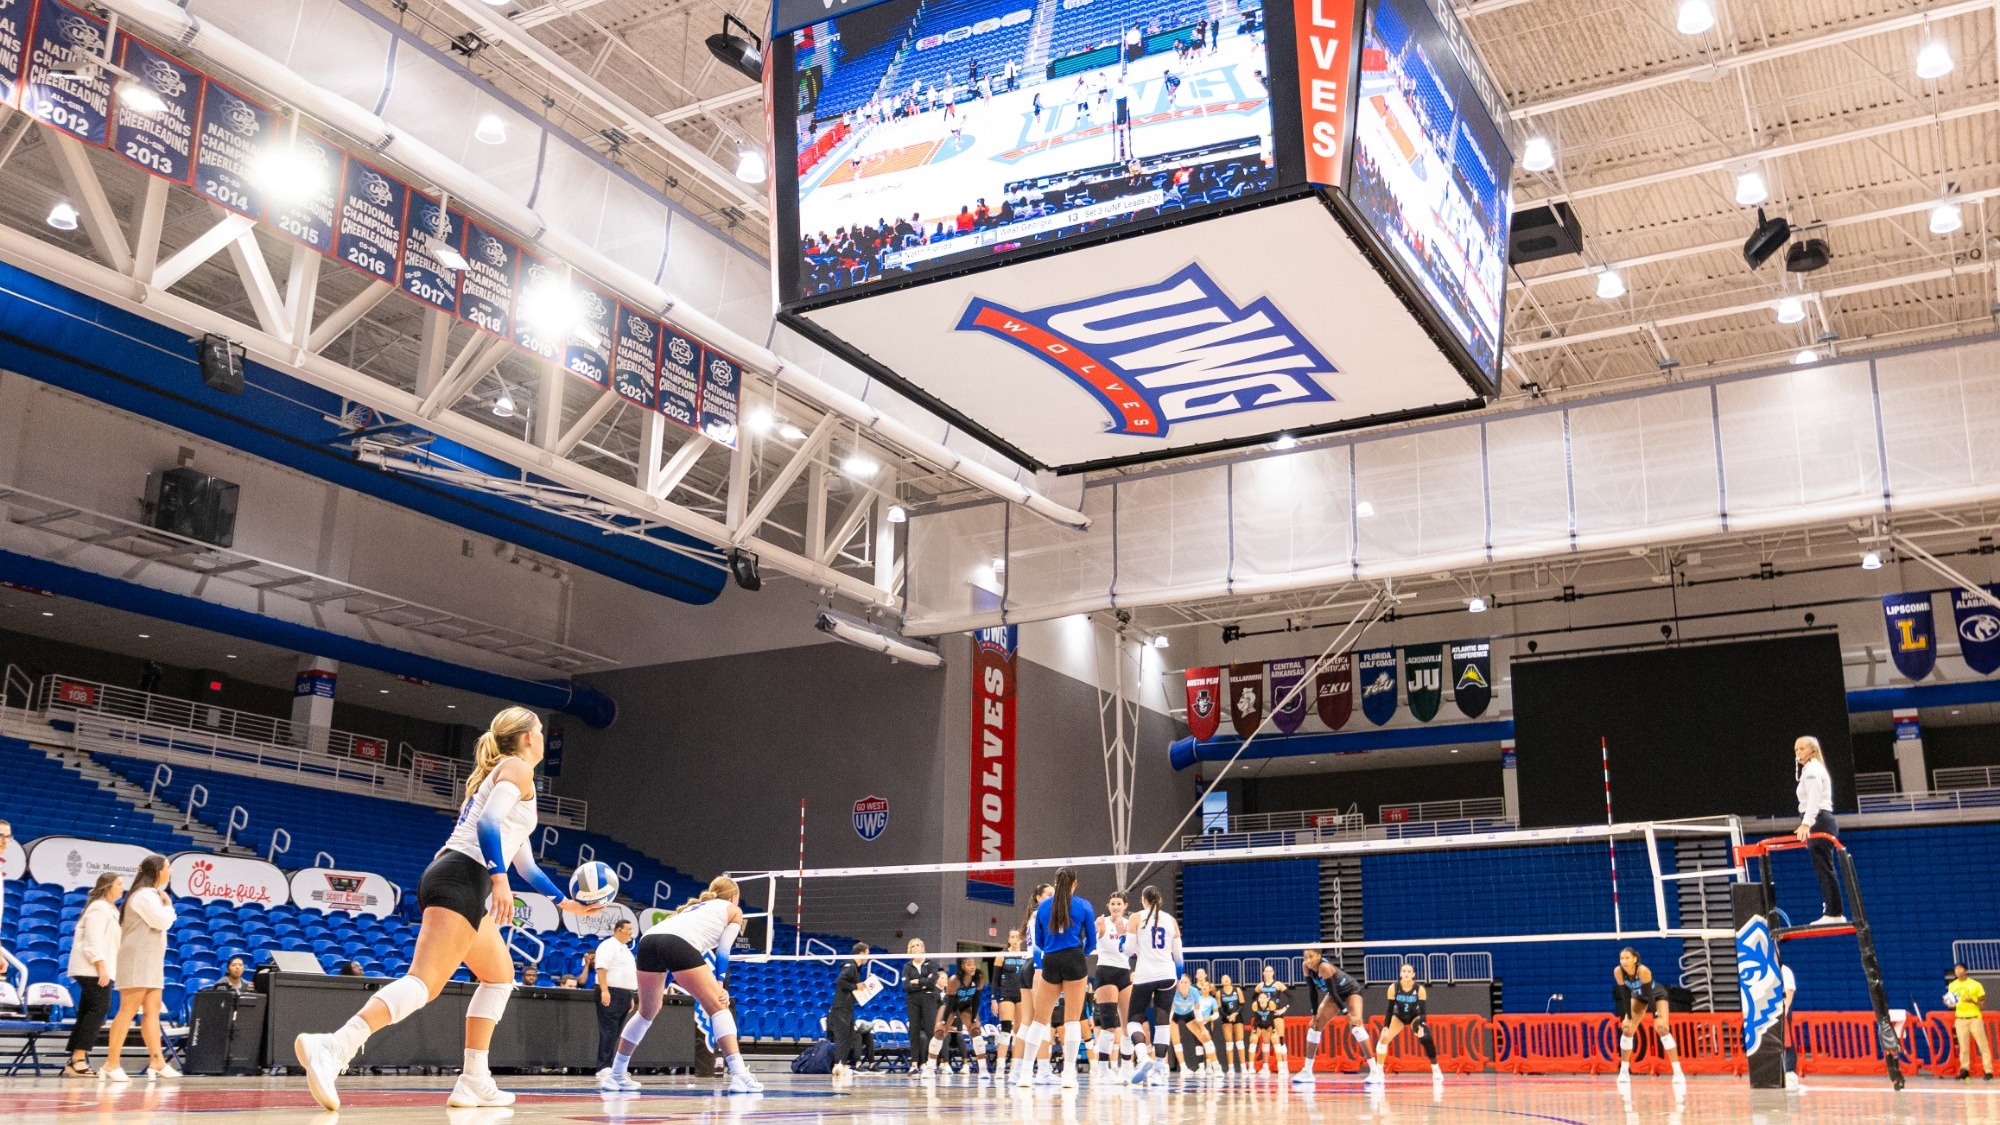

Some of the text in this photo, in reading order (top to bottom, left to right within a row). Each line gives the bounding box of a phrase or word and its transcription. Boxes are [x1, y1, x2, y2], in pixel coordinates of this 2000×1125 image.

[1436, 0, 1505, 134] GEORGIA
[30, 64, 108, 117] CHEERLEADING
[51, 92, 86, 114] ALL-GIRL
[37, 100, 89, 136] 2012
[119, 107, 189, 157] CHEERLEADING
[135, 134, 167, 154] ALL-GIRL
[125, 141, 173, 174] 2013
[219, 174, 242, 189] CO-ED
[206, 180, 249, 211] 2014
[1124, 197, 1145, 209] Leads
[342, 205, 400, 241] CHAMPIONS
[349, 195, 396, 228] NATIONAL
[1067, 213, 1079, 223] 13
[278, 214, 319, 245] 2015
[341, 217, 398, 260] CHEERLEADING
[973, 236, 980, 245] 7
[347, 247, 386, 275] 2016
[404, 249, 457, 290] CHEERLEADING
[469, 258, 509, 286] NATIONAL
[410, 279, 446, 305] 2017
[464, 268, 512, 299] CHAMPIONS
[468, 307, 501, 332] 2018
[521, 334, 553, 358] 2019
[1047, 278, 1317, 421] UWG
[571, 357, 602, 382] 2020
[660, 366, 698, 392] CHAMPIONS
[664, 358, 696, 382] NATIONAL
[1002, 320, 1150, 428] WOLVES
[619, 382, 647, 404] 2021
[703, 389, 737, 413] CHAMPIONS
[706, 381, 736, 402] NATIONAL
[663, 401, 690, 424] 2022
[1886, 602, 1930, 615] LIPSCOMB
[983, 625, 1007, 650] UWG
[1896, 618, 1927, 651] L
[1364, 652, 1391, 661] FLORIDA
[1405, 654, 1442, 664] JACKSONVILLE
[1452, 643, 1489, 653] ATLANTIC SUN
[1453, 651, 1488, 659] CONFERENCE
[1271, 668, 1305, 678] ARKANSAS
[1272, 661, 1302, 671] CENTRAL
[1360, 659, 1396, 669] GULF COAST
[297, 682, 311, 693] 108
[1206, 677, 1219, 685] PEAY
[1229, 673, 1263, 683] BELLARMINE
[1320, 682, 1351, 695] EKU
[1408, 668, 1440, 692] JU
[68, 690, 87, 701] 108
[361, 746, 376, 756] 108
[981, 666, 1004, 868] WOLVES
[856, 801, 885, 811] GO WEST
[1390, 813, 1402, 821] 111
[855, 812, 885, 837] UWG
[85, 861, 101, 870] Oak
[188, 868, 272, 903] Chick-fil-A
[326, 892, 343, 902] SCOTT
[1151, 926, 1166, 949] 13
